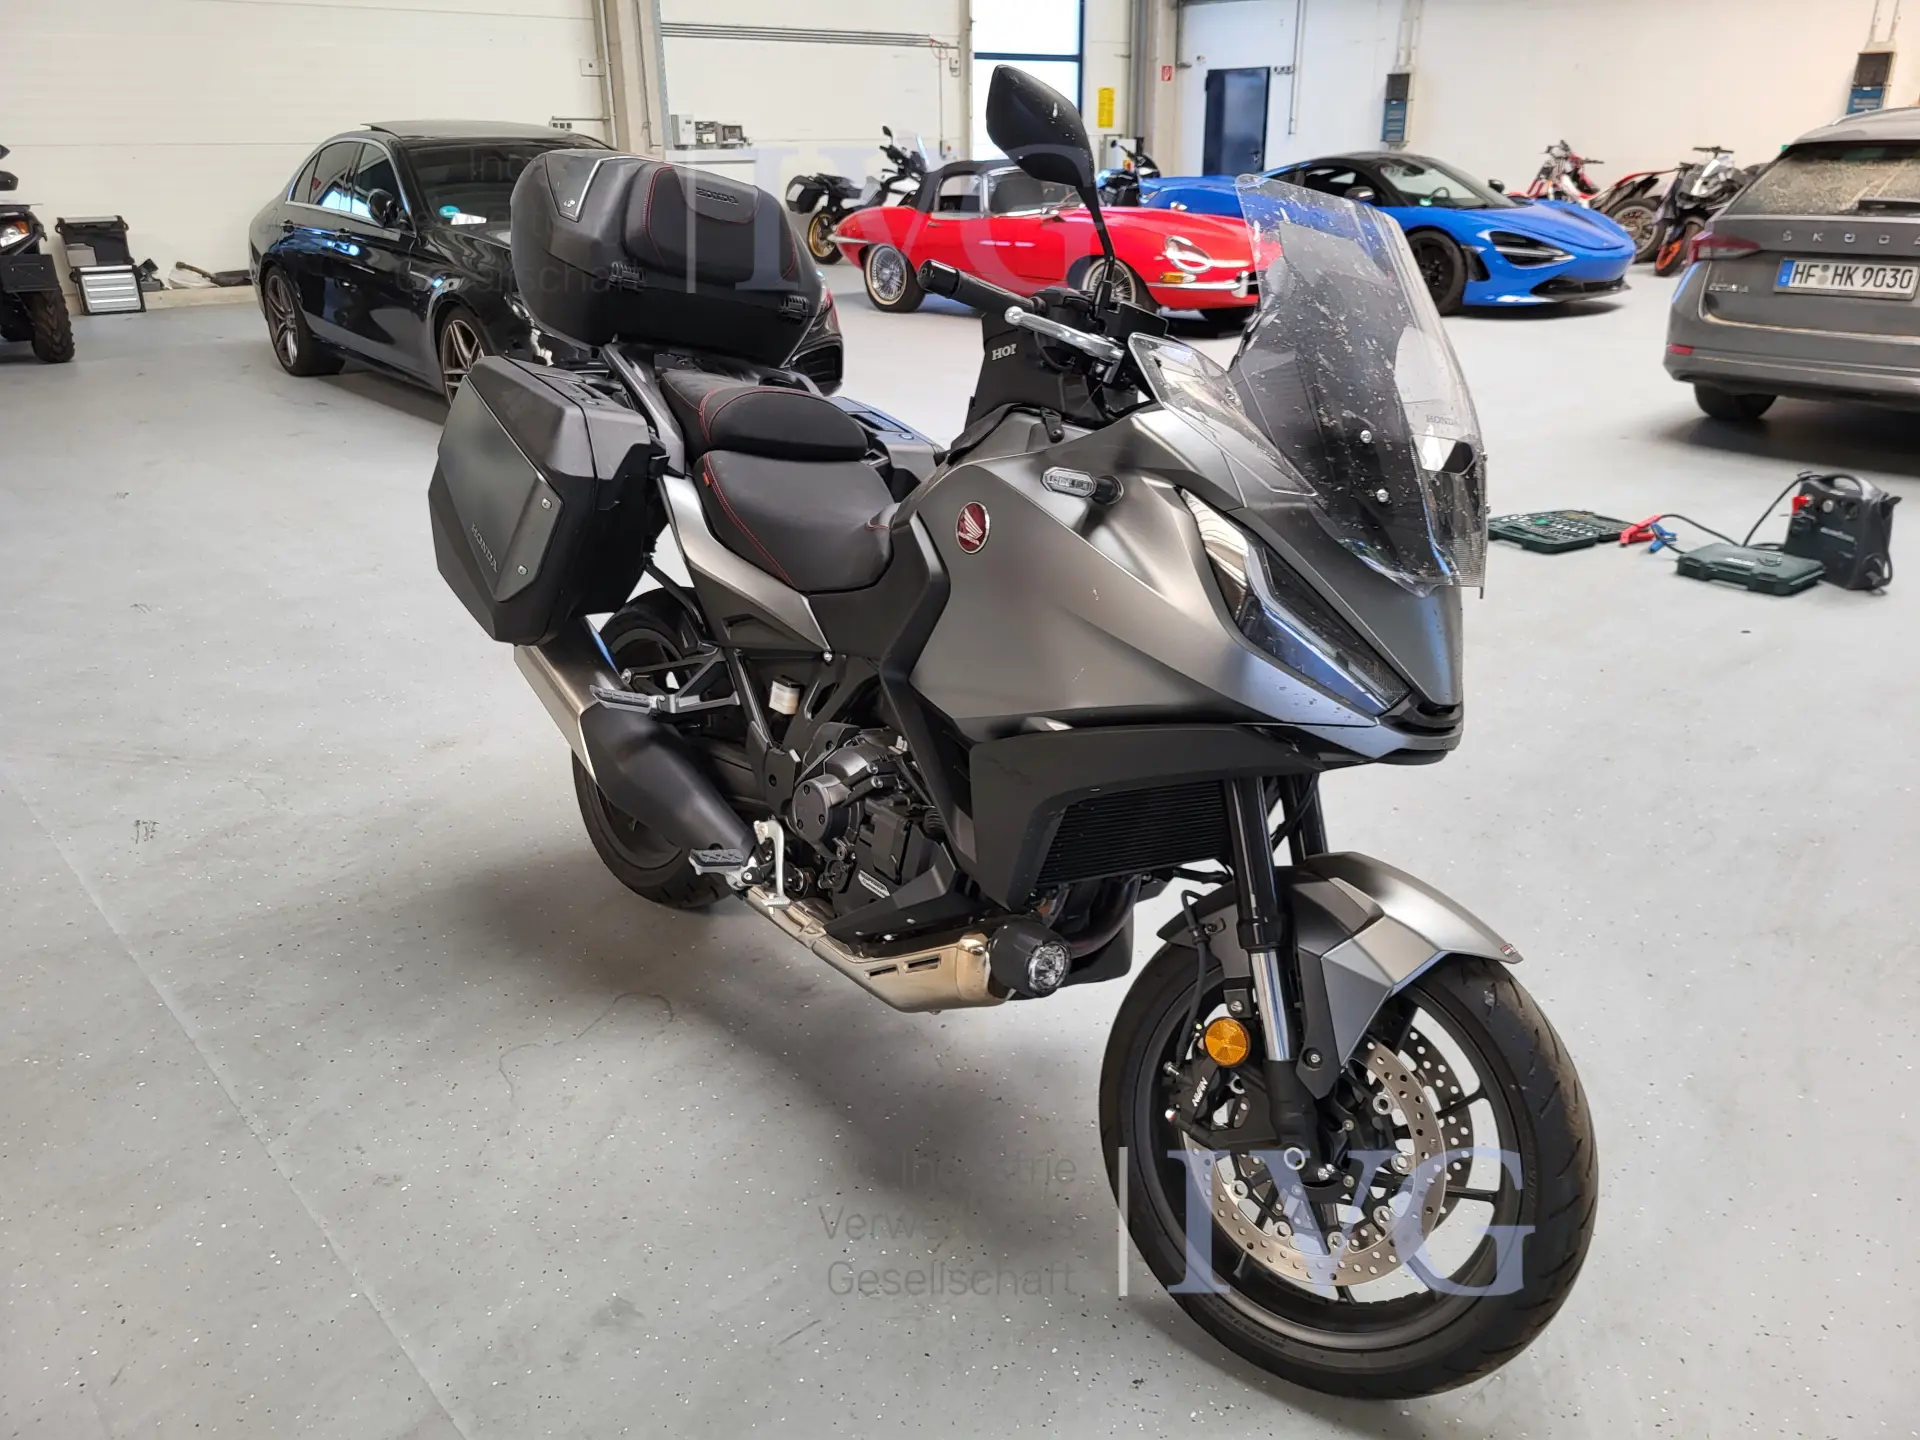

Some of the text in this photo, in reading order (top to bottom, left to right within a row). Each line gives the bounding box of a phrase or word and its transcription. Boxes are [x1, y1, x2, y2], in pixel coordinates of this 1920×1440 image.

[1792, 264, 1913, 289] HF HK 9030
[471, 521, 498, 573] HONDA
